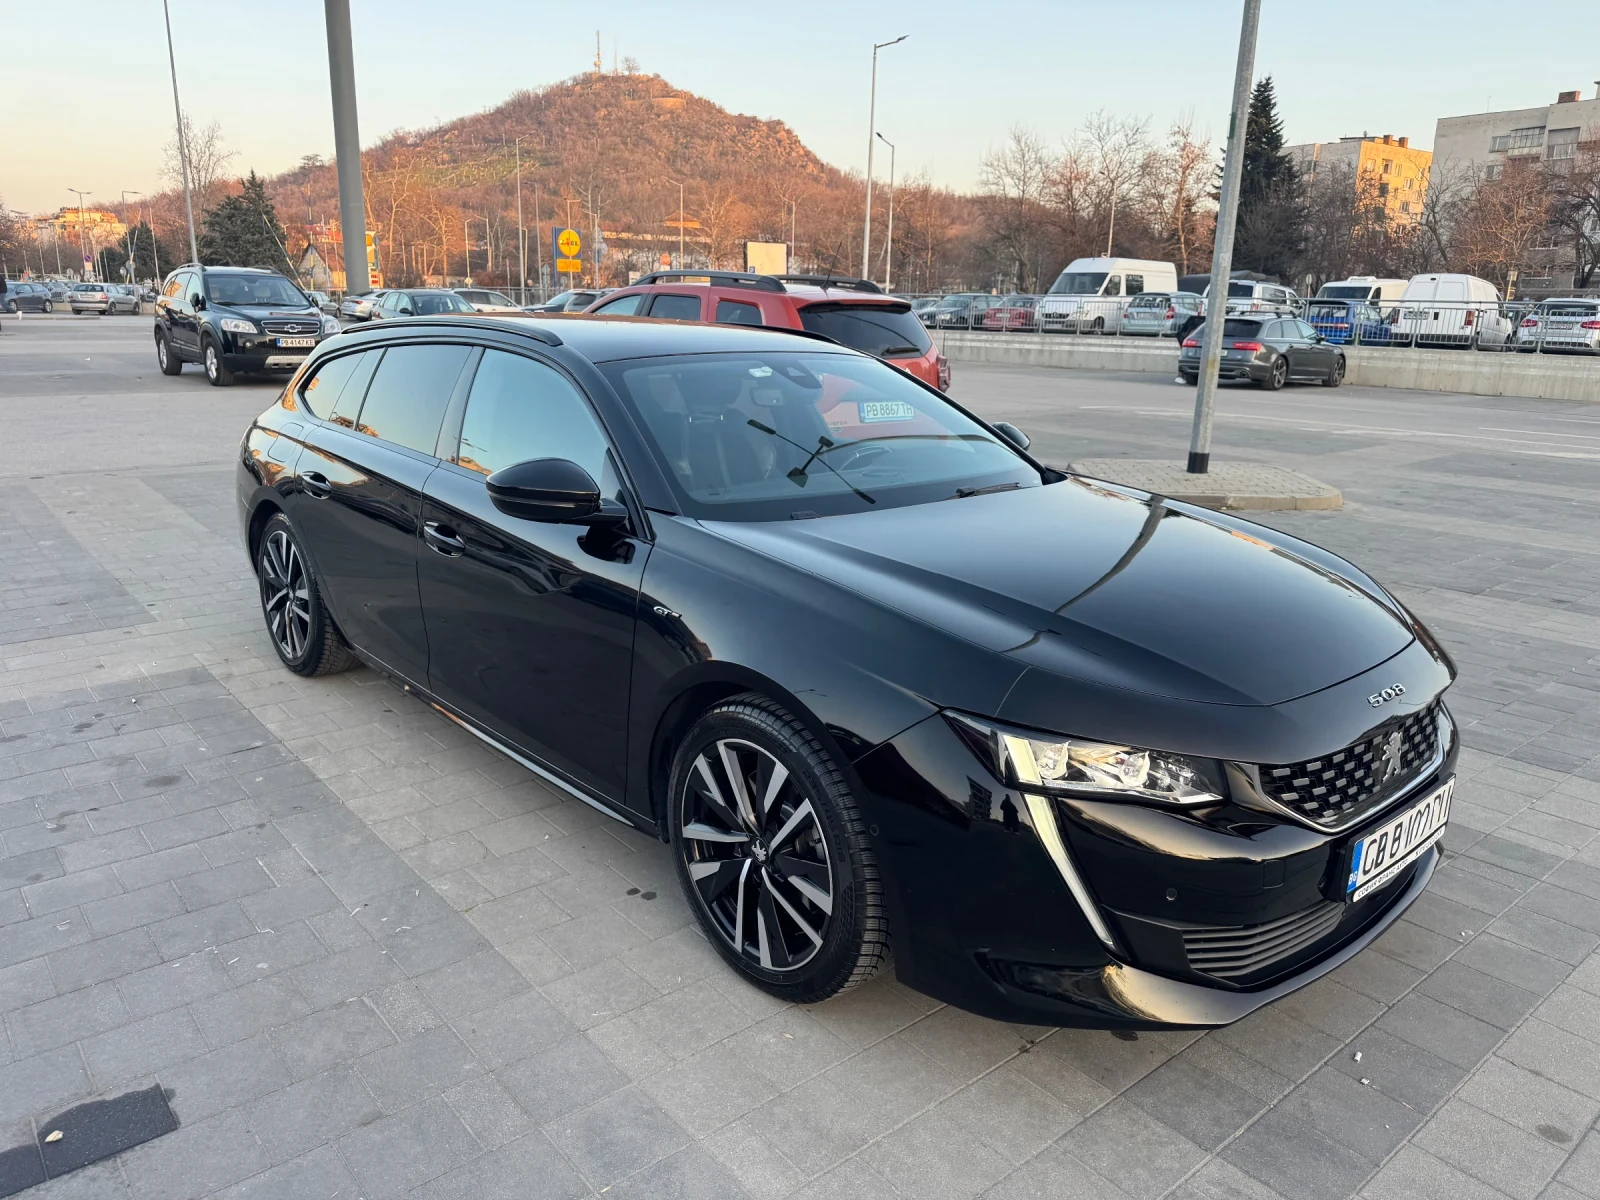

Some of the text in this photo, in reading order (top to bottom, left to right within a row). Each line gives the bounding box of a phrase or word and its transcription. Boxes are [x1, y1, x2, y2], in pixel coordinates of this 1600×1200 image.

[865, 404, 879, 417] PB
[879, 403, 900, 416] 8867
[1367, 683, 1406, 707] 508
